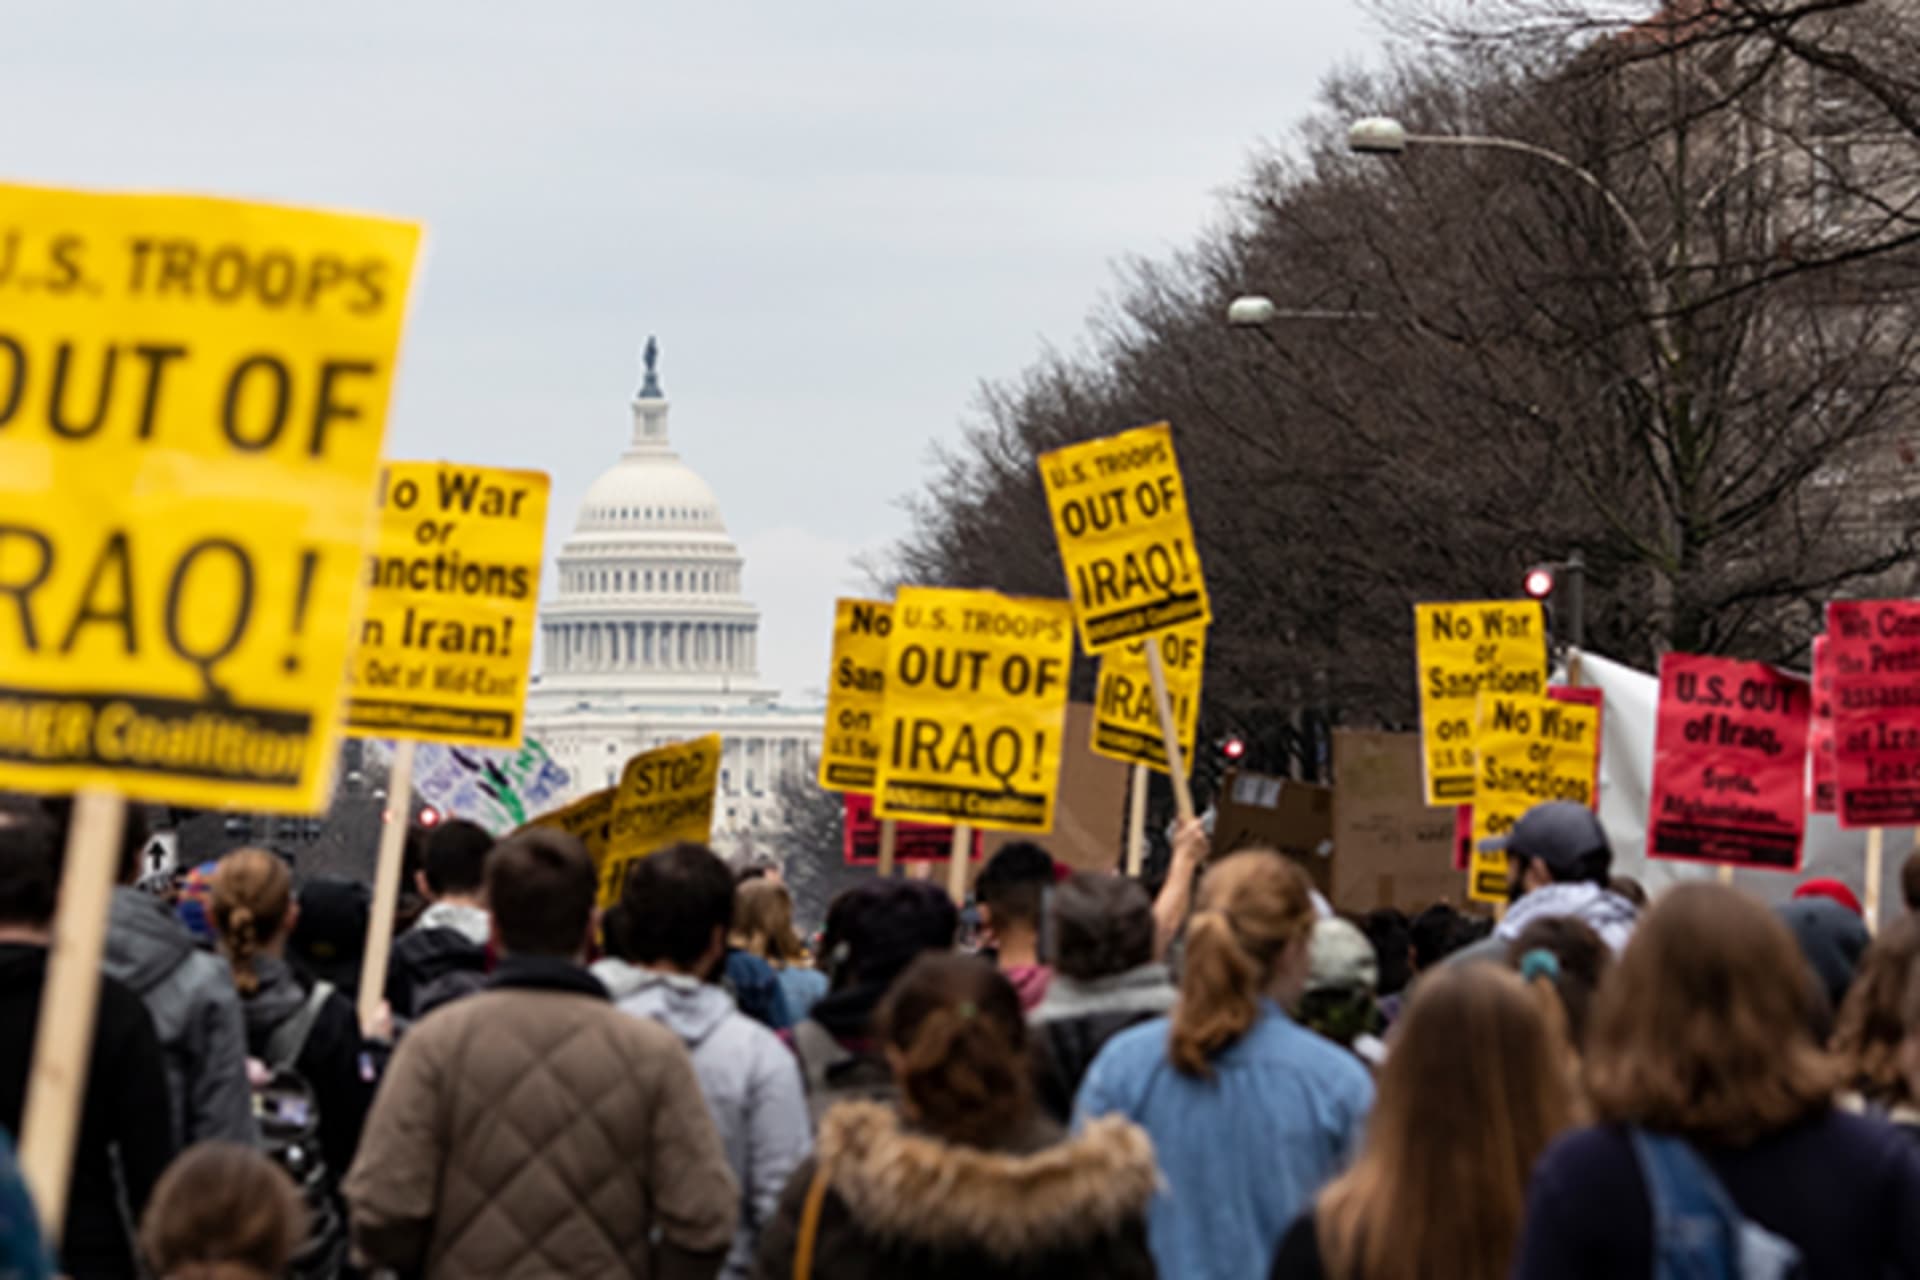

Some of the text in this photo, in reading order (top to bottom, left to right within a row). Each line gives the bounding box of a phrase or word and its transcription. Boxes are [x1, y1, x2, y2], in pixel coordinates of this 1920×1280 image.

[125, 237, 390, 315] TROOPS
[220, 352, 377, 458] OF
[1050, 441, 1168, 489] U.S. TROOPS
[437, 472, 528, 517] War
[1061, 475, 1177, 537] OUT OF
[416, 519, 456, 544] or
[366, 551, 529, 600] anctions
[1077, 538, 1191, 609] IRAQ!
[0, 525, 320, 703] RAQ!
[360, 608, 513, 657] n Iran!
[850, 606, 892, 637] No
[904, 606, 954, 633] U.S.
[962, 609, 1063, 643] TROOPS
[1432, 609, 1531, 640] No War
[1838, 609, 1871, 638] We
[900, 644, 1061, 697] OUT OF
[1162, 633, 1198, 669] OF
[1474, 643, 1497, 664] or
[1429, 664, 1540, 699] Sanctions
[1677, 672, 1793, 714] U.S. OUT
[838, 709, 871, 732] on
[1101, 673, 1188, 736] IRA!
[1493, 702, 1586, 742] No War
[1437, 719, 1468, 742] on
[1529, 742, 1552, 763] or
[1684, 712, 1782, 755] of Iraq,
[635, 751, 705, 796] STOP
[892, 717, 1045, 792] IRAQ!
[1484, 756, 1588, 801] Sanctions
